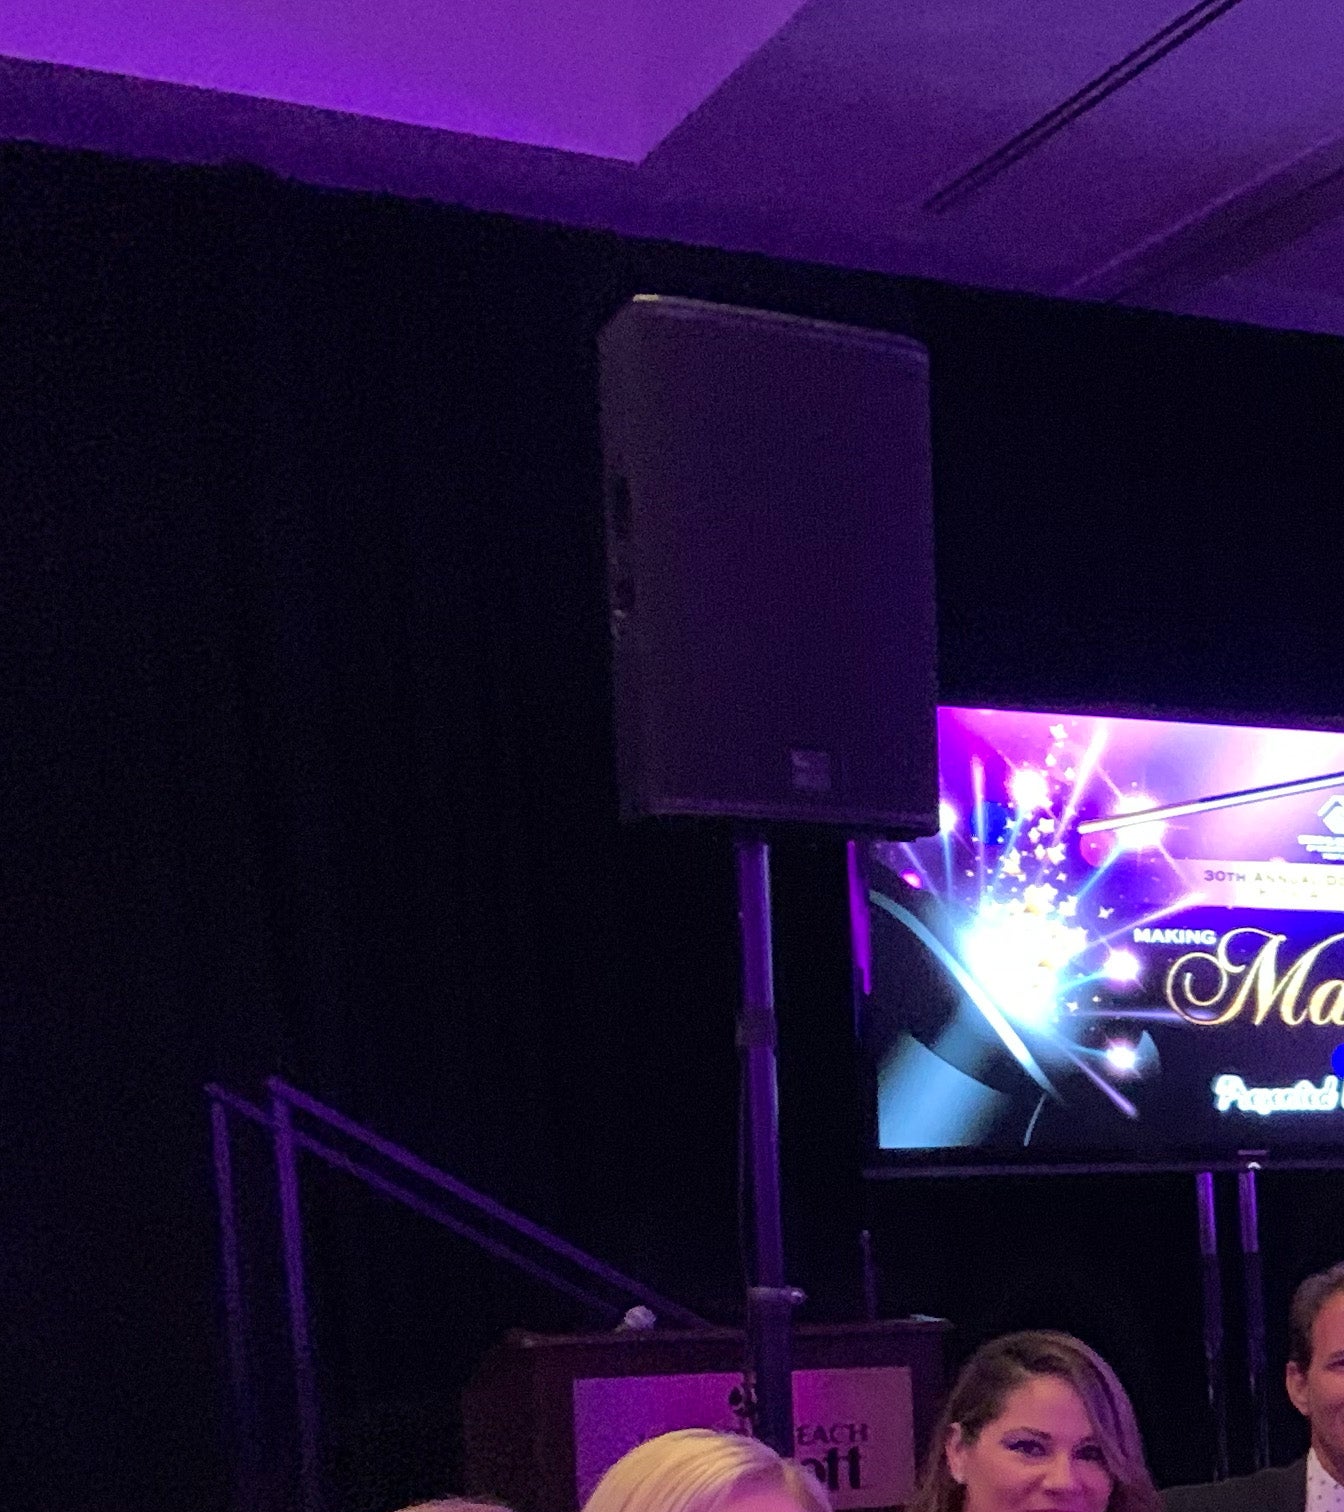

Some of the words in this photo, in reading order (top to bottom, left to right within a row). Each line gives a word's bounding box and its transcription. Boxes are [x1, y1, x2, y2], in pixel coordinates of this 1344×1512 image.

[1204, 870, 1246, 882] 30TH
[1133, 928, 1217, 945] MAKING
[796, 1422, 869, 1444] EACH
